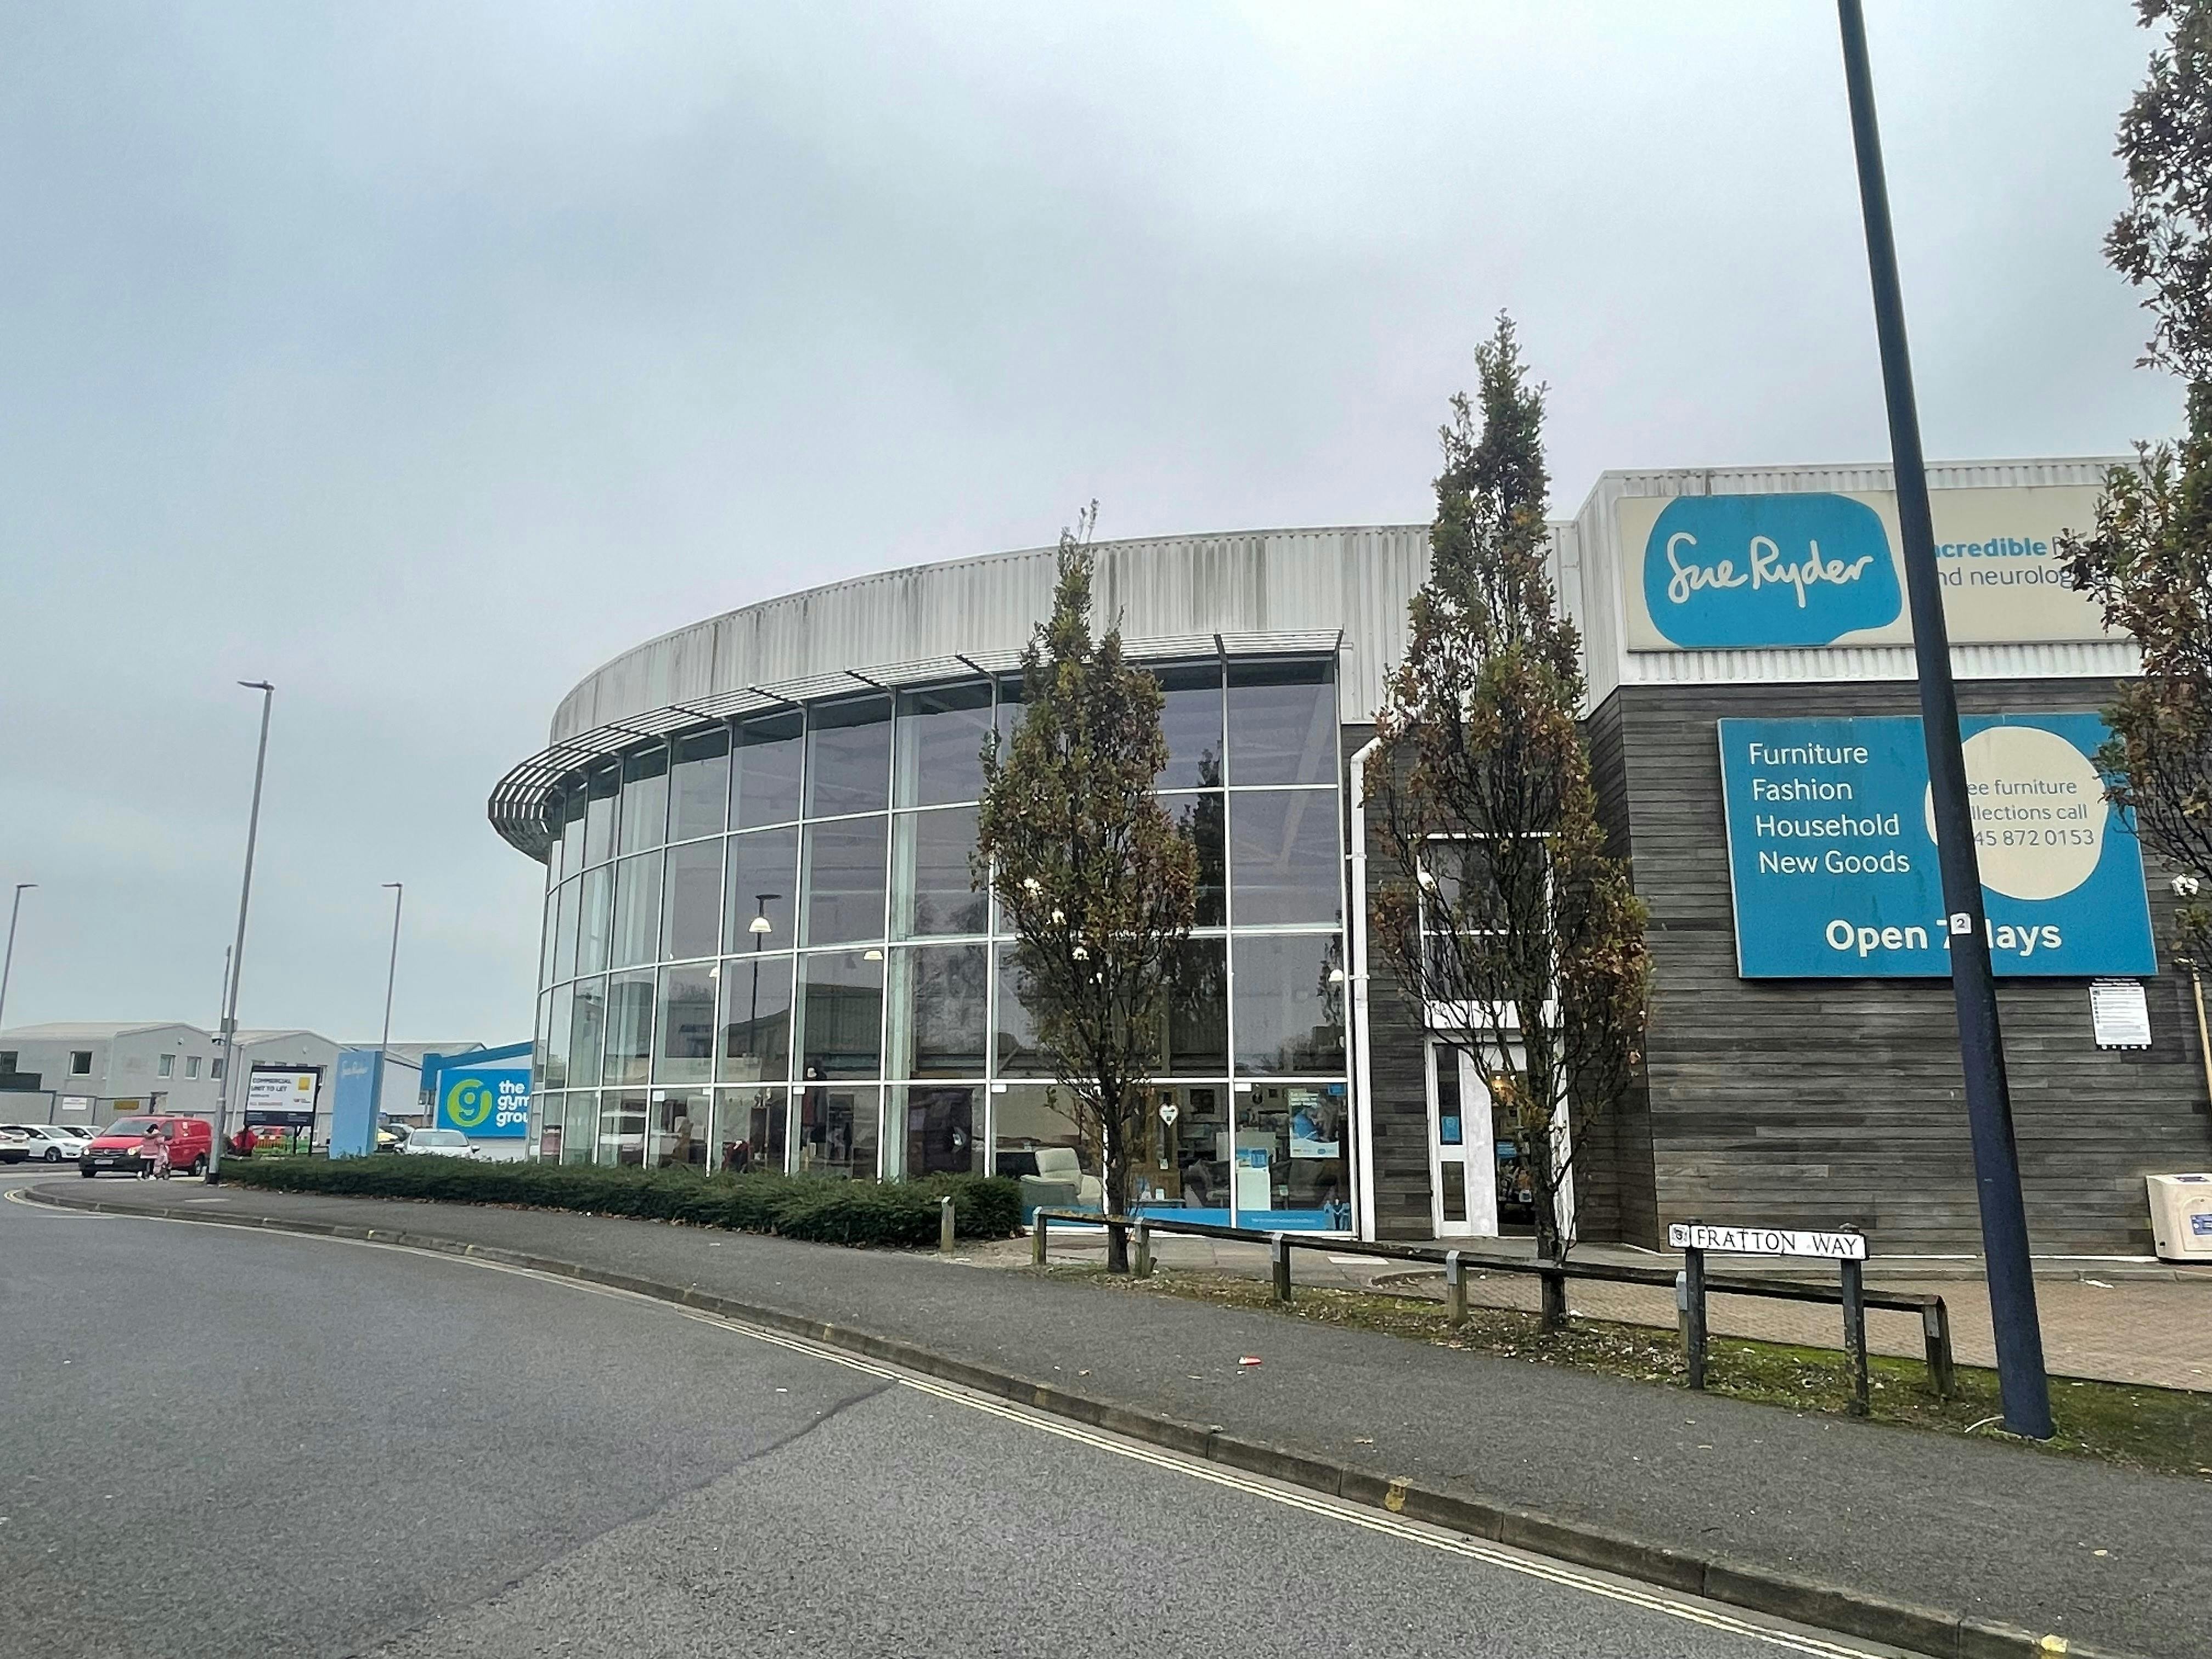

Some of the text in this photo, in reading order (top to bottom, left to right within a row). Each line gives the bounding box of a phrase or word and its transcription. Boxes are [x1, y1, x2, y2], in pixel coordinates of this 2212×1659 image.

[1667, 532, 1874, 608] Sue Ryder
[1970, 565, 2075, 589] neurolog
[1748, 742, 1869, 765] Furniture
[1752, 777, 1853, 802] Fashion
[1967, 778, 2078, 795] ee furniture
[1971, 803, 2087, 821] llections call
[1756, 813, 1900, 837] Household
[1975, 828, 2095, 846] 45 872 0153
[1759, 849, 1911, 873] New Goods
[1956, 918, 1965, 928] 2
[1825, 919, 1928, 957] Open
[498, 1080, 526, 1094] the
[1697, 1228, 1858, 1256] FRATTON WAY
